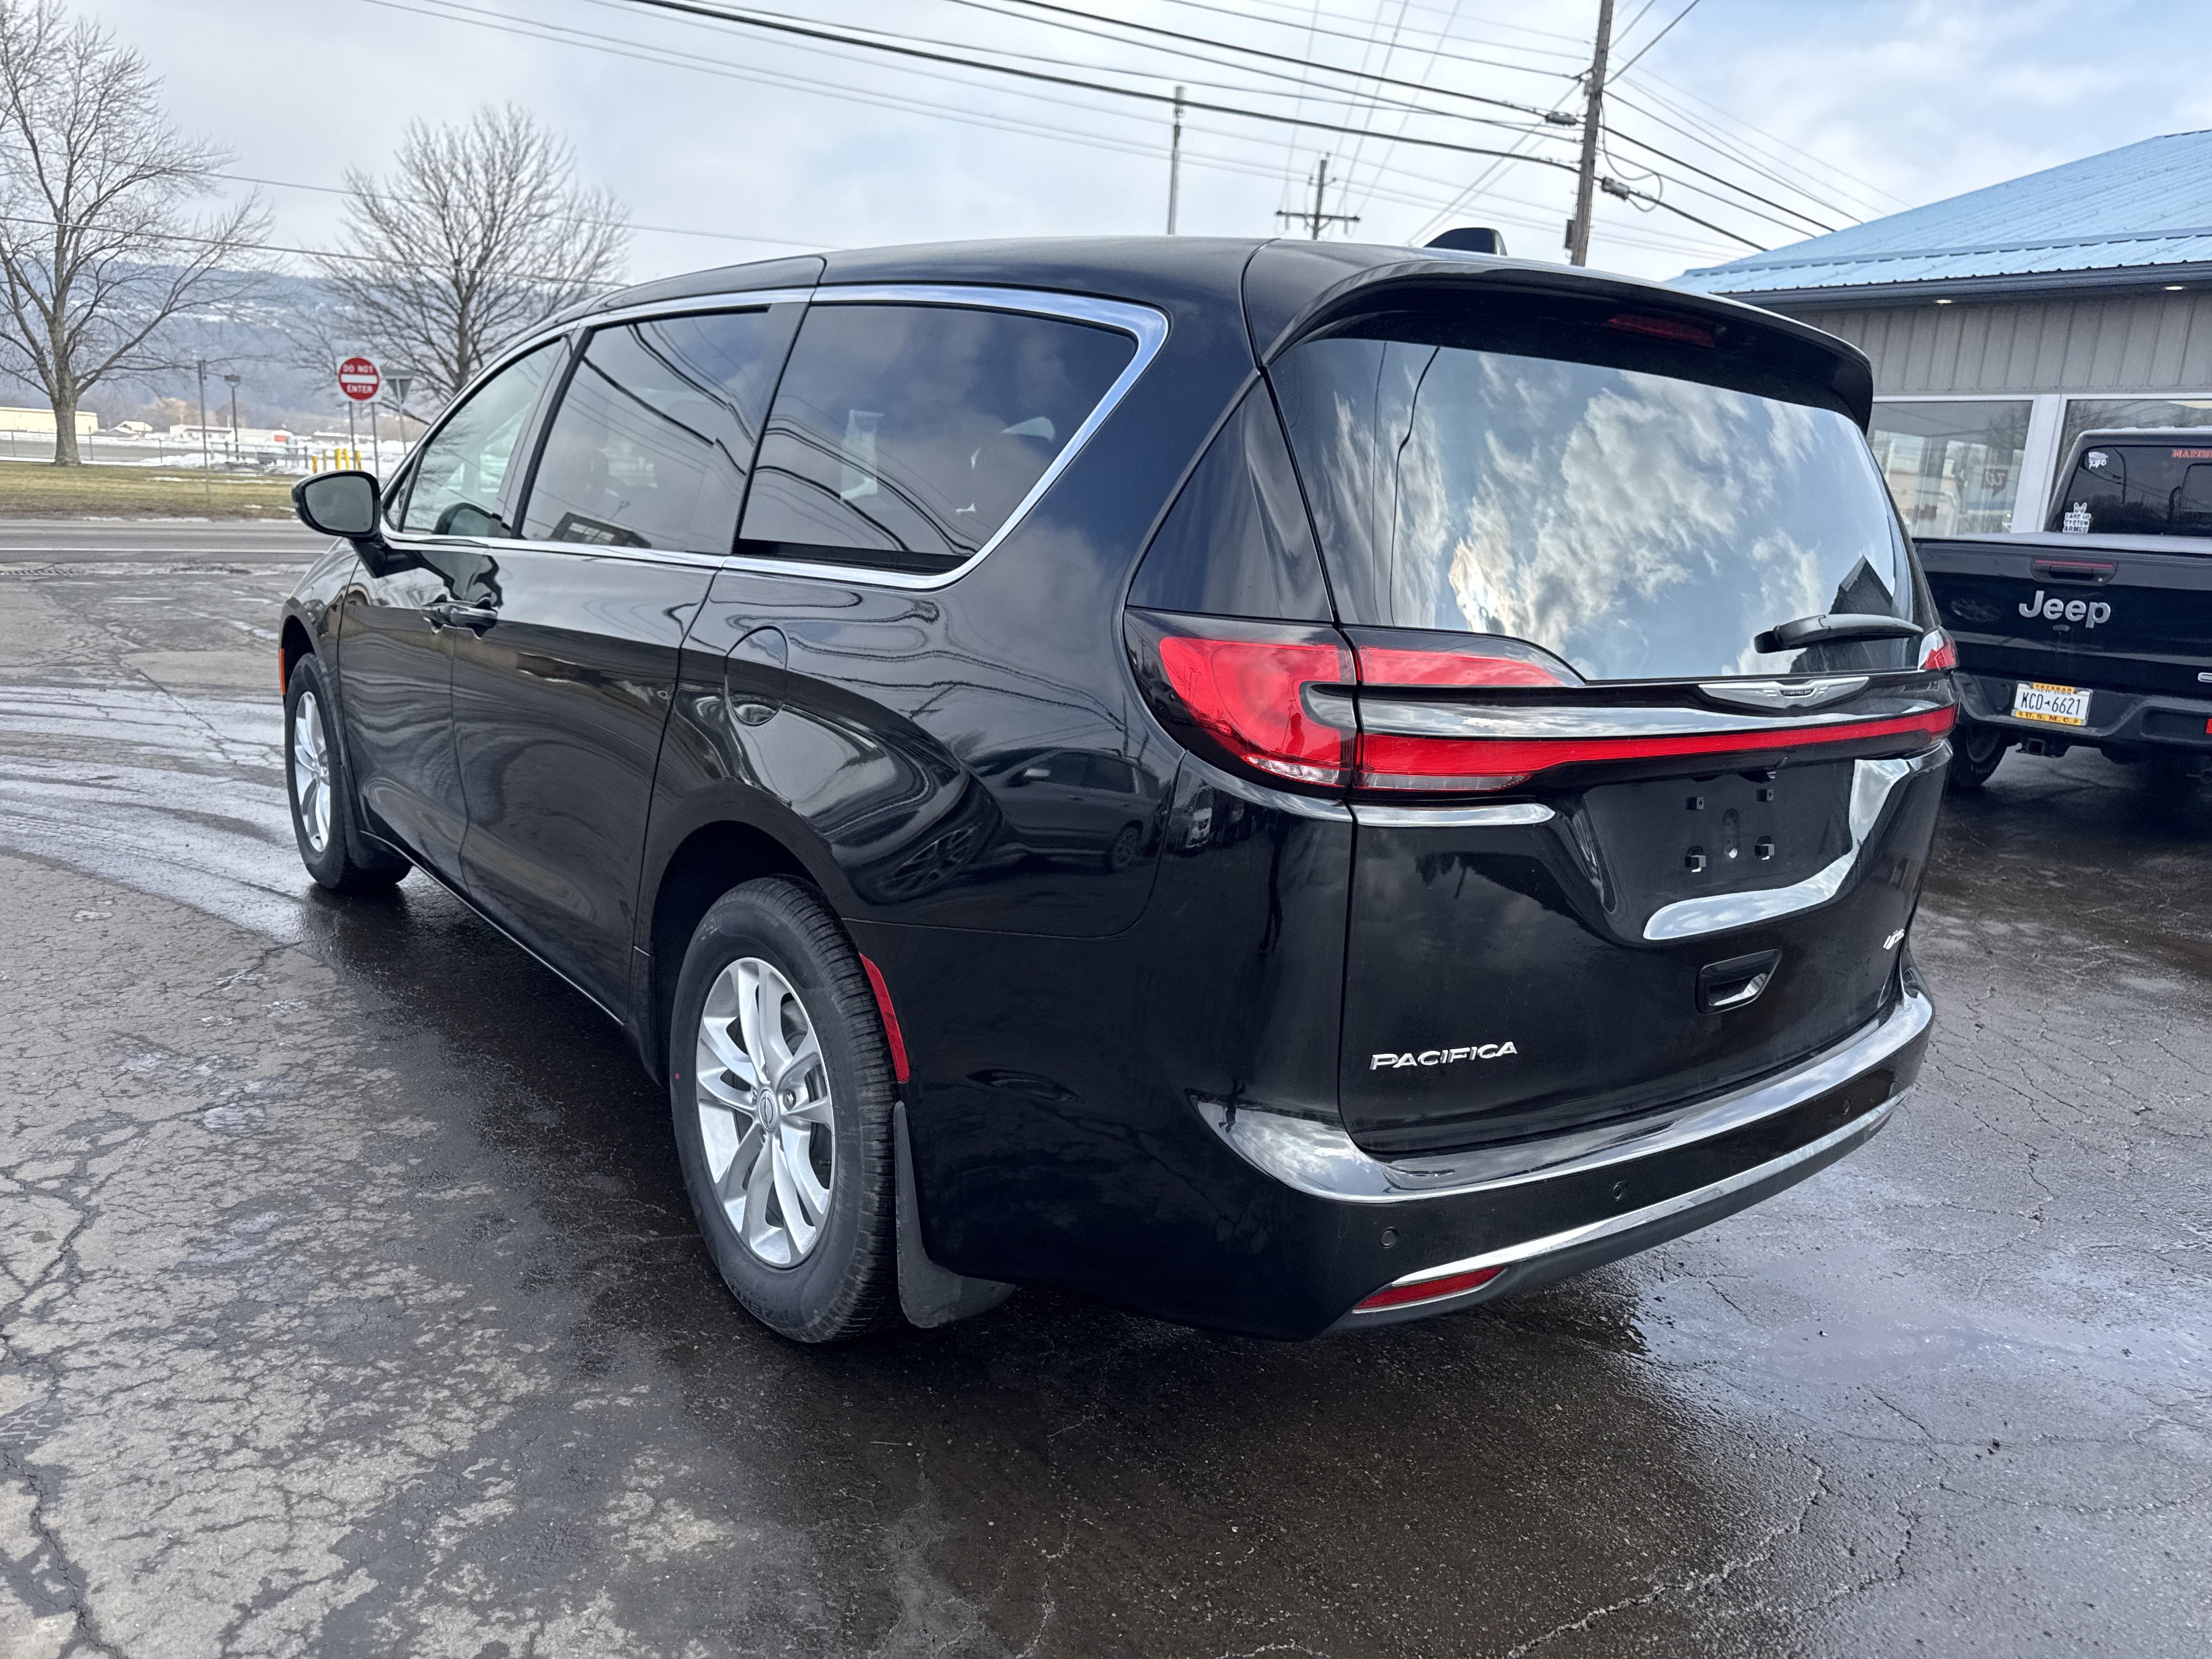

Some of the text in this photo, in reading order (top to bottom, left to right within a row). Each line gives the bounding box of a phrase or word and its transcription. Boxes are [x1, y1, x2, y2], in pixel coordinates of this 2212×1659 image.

[342, 364, 373, 374] DO NOT
[346, 384, 373, 394] ENTER
[2019, 590, 2111, 629] Jeep
[2035, 684, 2072, 692] VETERAN
[1370, 1041, 1518, 1070] PACIFICA
